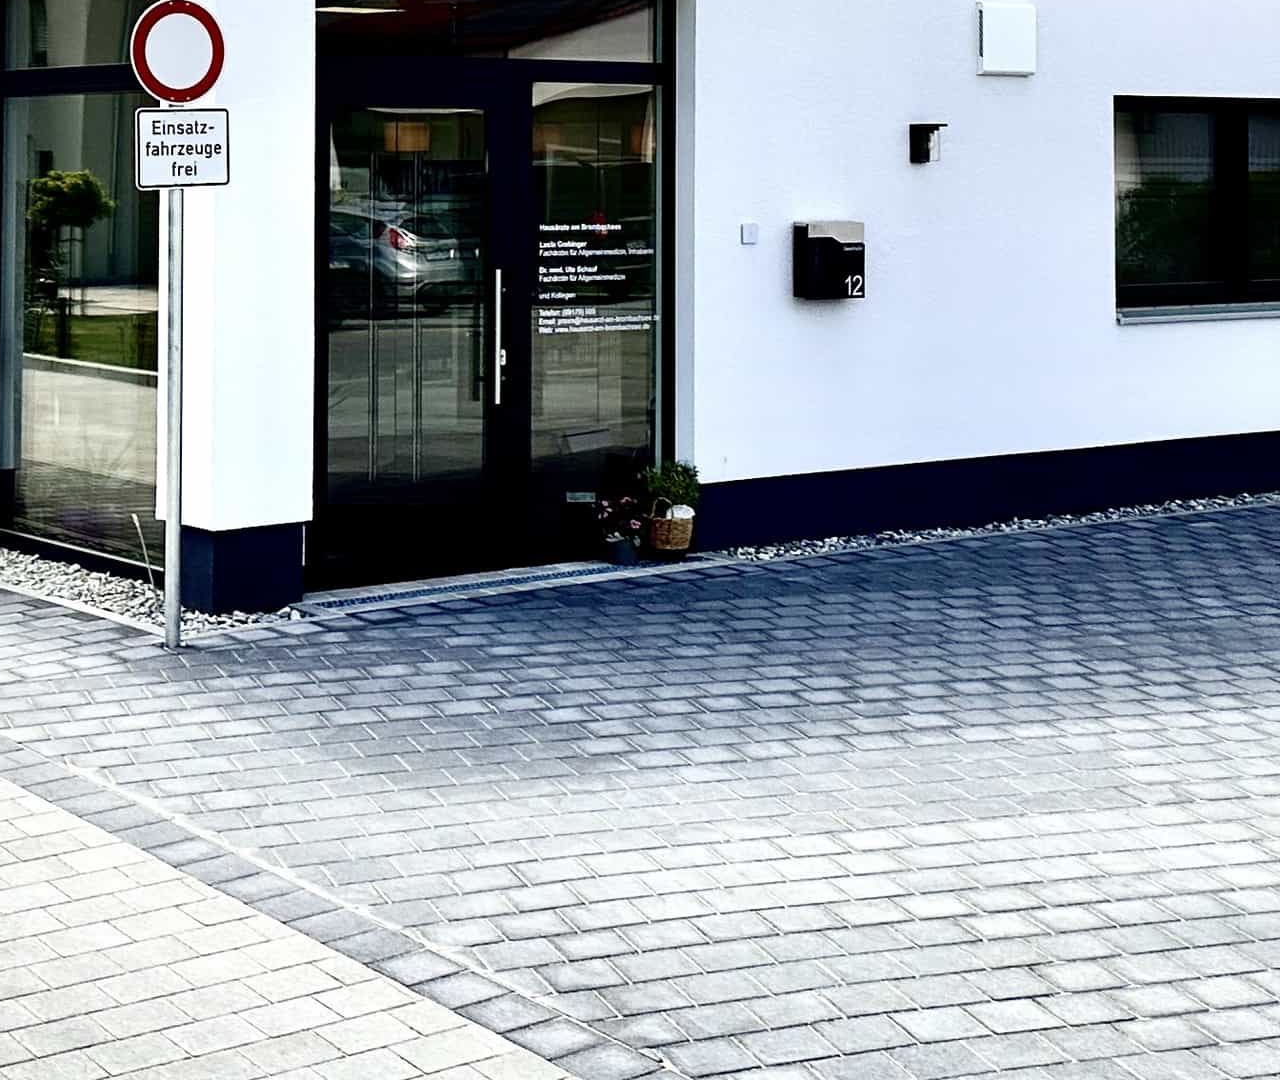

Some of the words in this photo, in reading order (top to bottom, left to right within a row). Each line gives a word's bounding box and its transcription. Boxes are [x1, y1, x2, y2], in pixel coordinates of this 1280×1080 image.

[151, 120, 215, 135] Einsatz-
[145, 141, 222, 159] fahrzeuge
[172, 161, 197, 176] frei
[844, 275, 863, 296] 12
